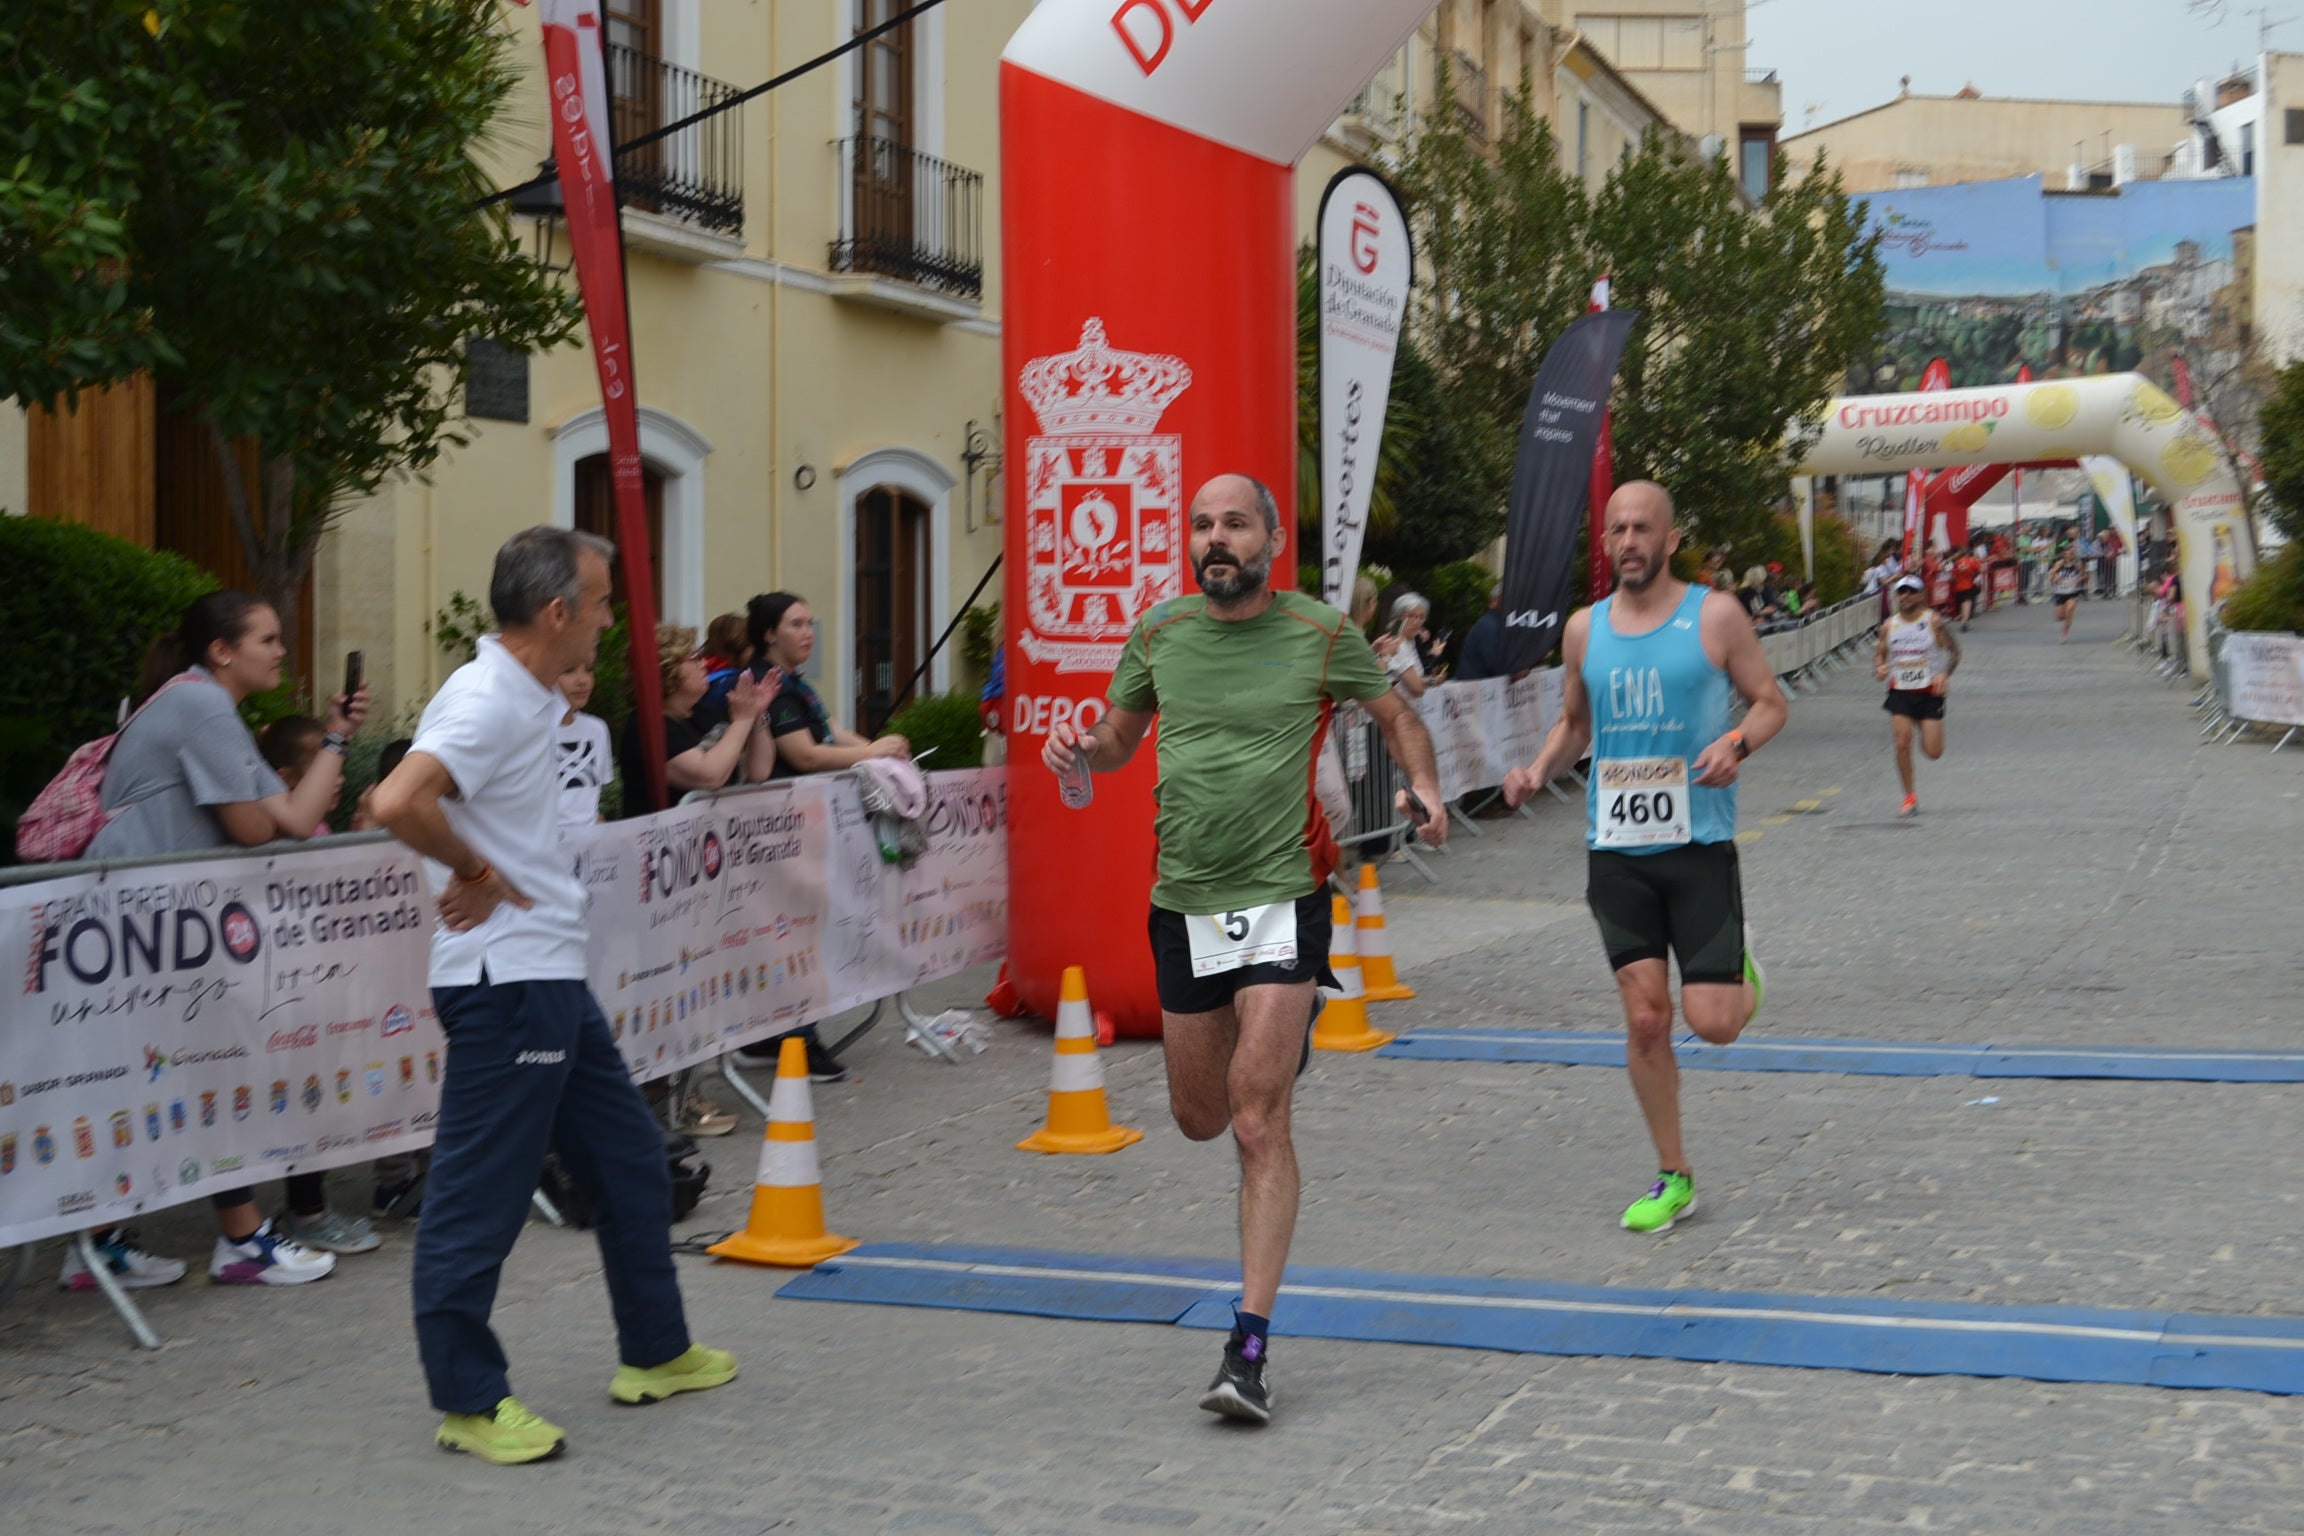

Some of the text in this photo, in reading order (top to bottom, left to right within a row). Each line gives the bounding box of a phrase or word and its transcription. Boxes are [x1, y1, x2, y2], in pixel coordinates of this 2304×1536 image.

[1326, 264, 1397, 310] Diputación
[1541, 391, 1596, 413] Movement
[1839, 396, 2011, 430] Cruzcampo
[1856, 435, 1940, 461] Radler
[1324, 378, 1363, 600] Deportes
[1609, 666, 1665, 719] ENA
[1610, 791, 1674, 825] 460
[265, 865, 419, 918] Diputación
[34, 901, 261, 994] FONDO
[273, 901, 422, 949] de Granada
[1225, 908, 1250, 941] 5
